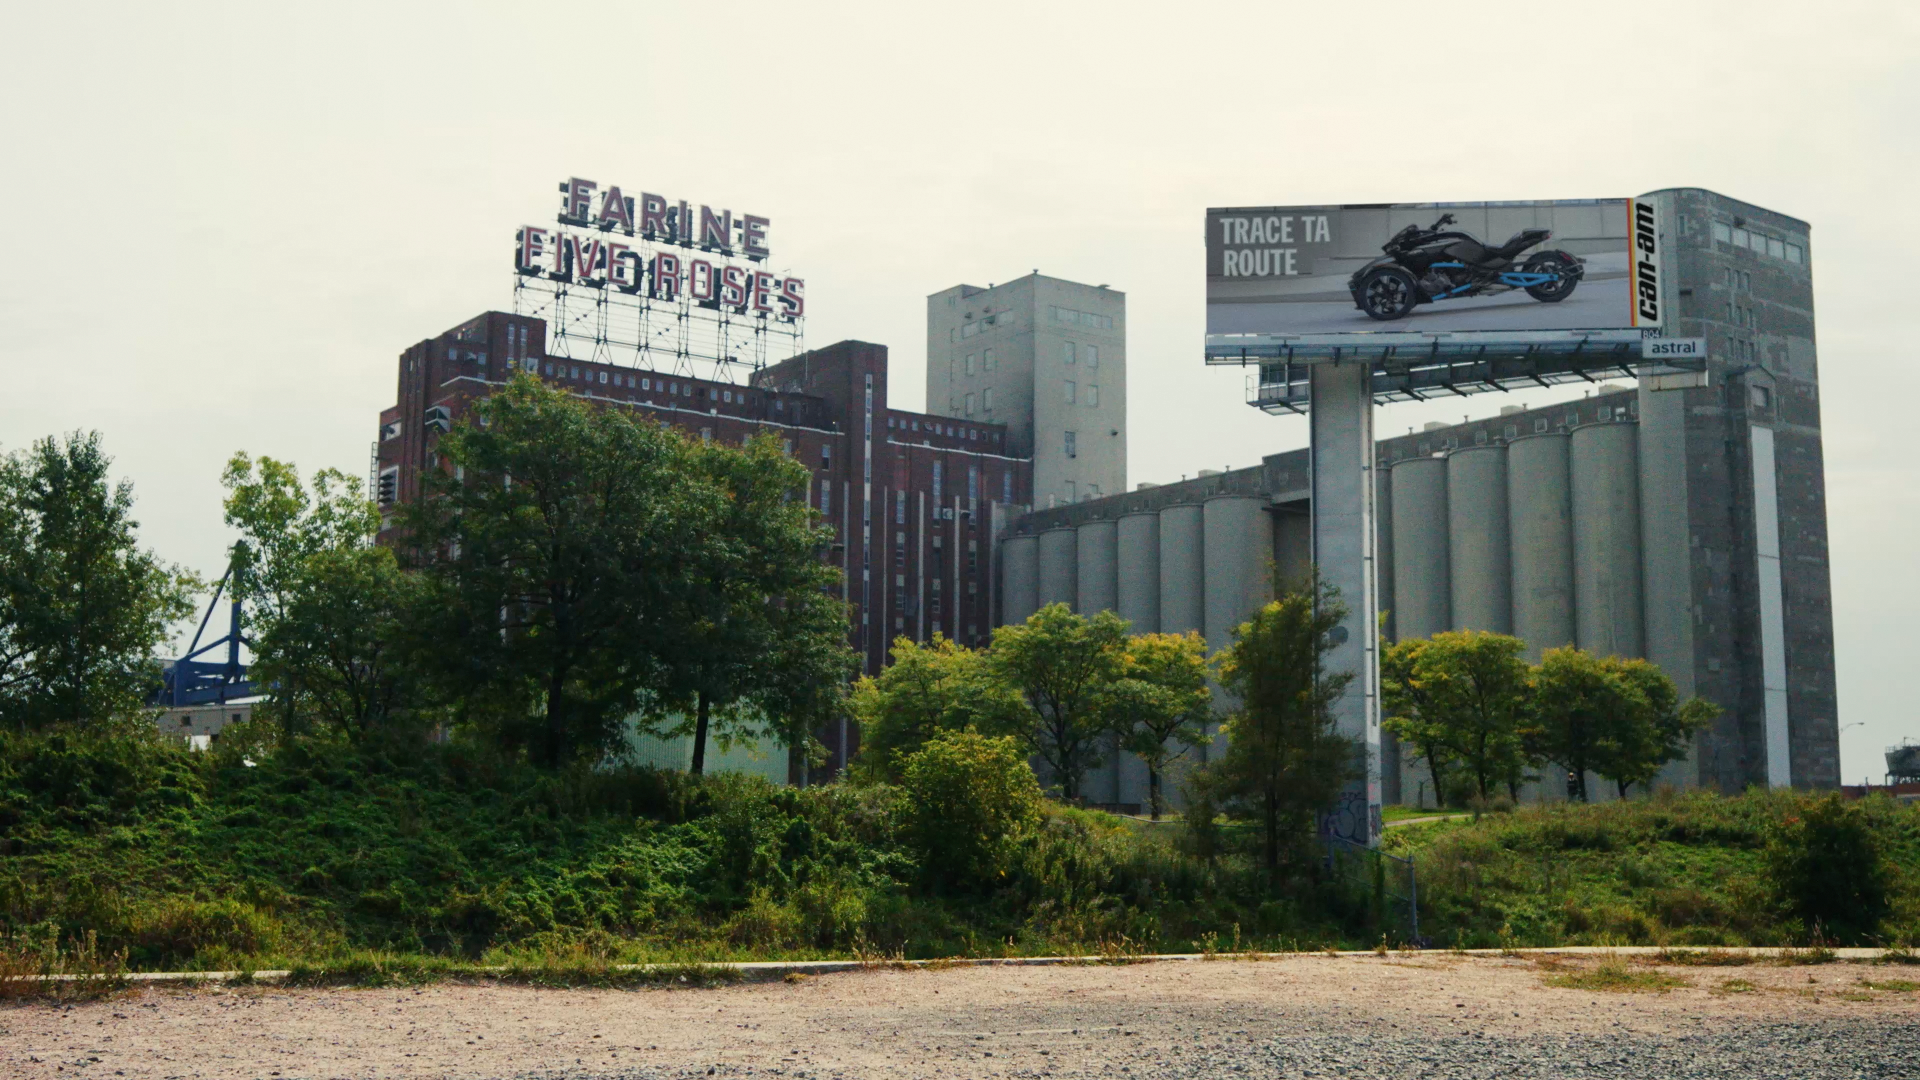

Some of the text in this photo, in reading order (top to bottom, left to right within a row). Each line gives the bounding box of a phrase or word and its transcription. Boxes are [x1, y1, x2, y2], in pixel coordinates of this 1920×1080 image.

[566, 176, 770, 257] FARINE
[1219, 215, 1330, 244] TRACE TA
[521, 225, 804, 318] FIVE ROSES
[1223, 249, 1298, 276] ROUTE
[1636, 202, 1657, 321] can-am
[1651, 341, 1696, 353] astral
